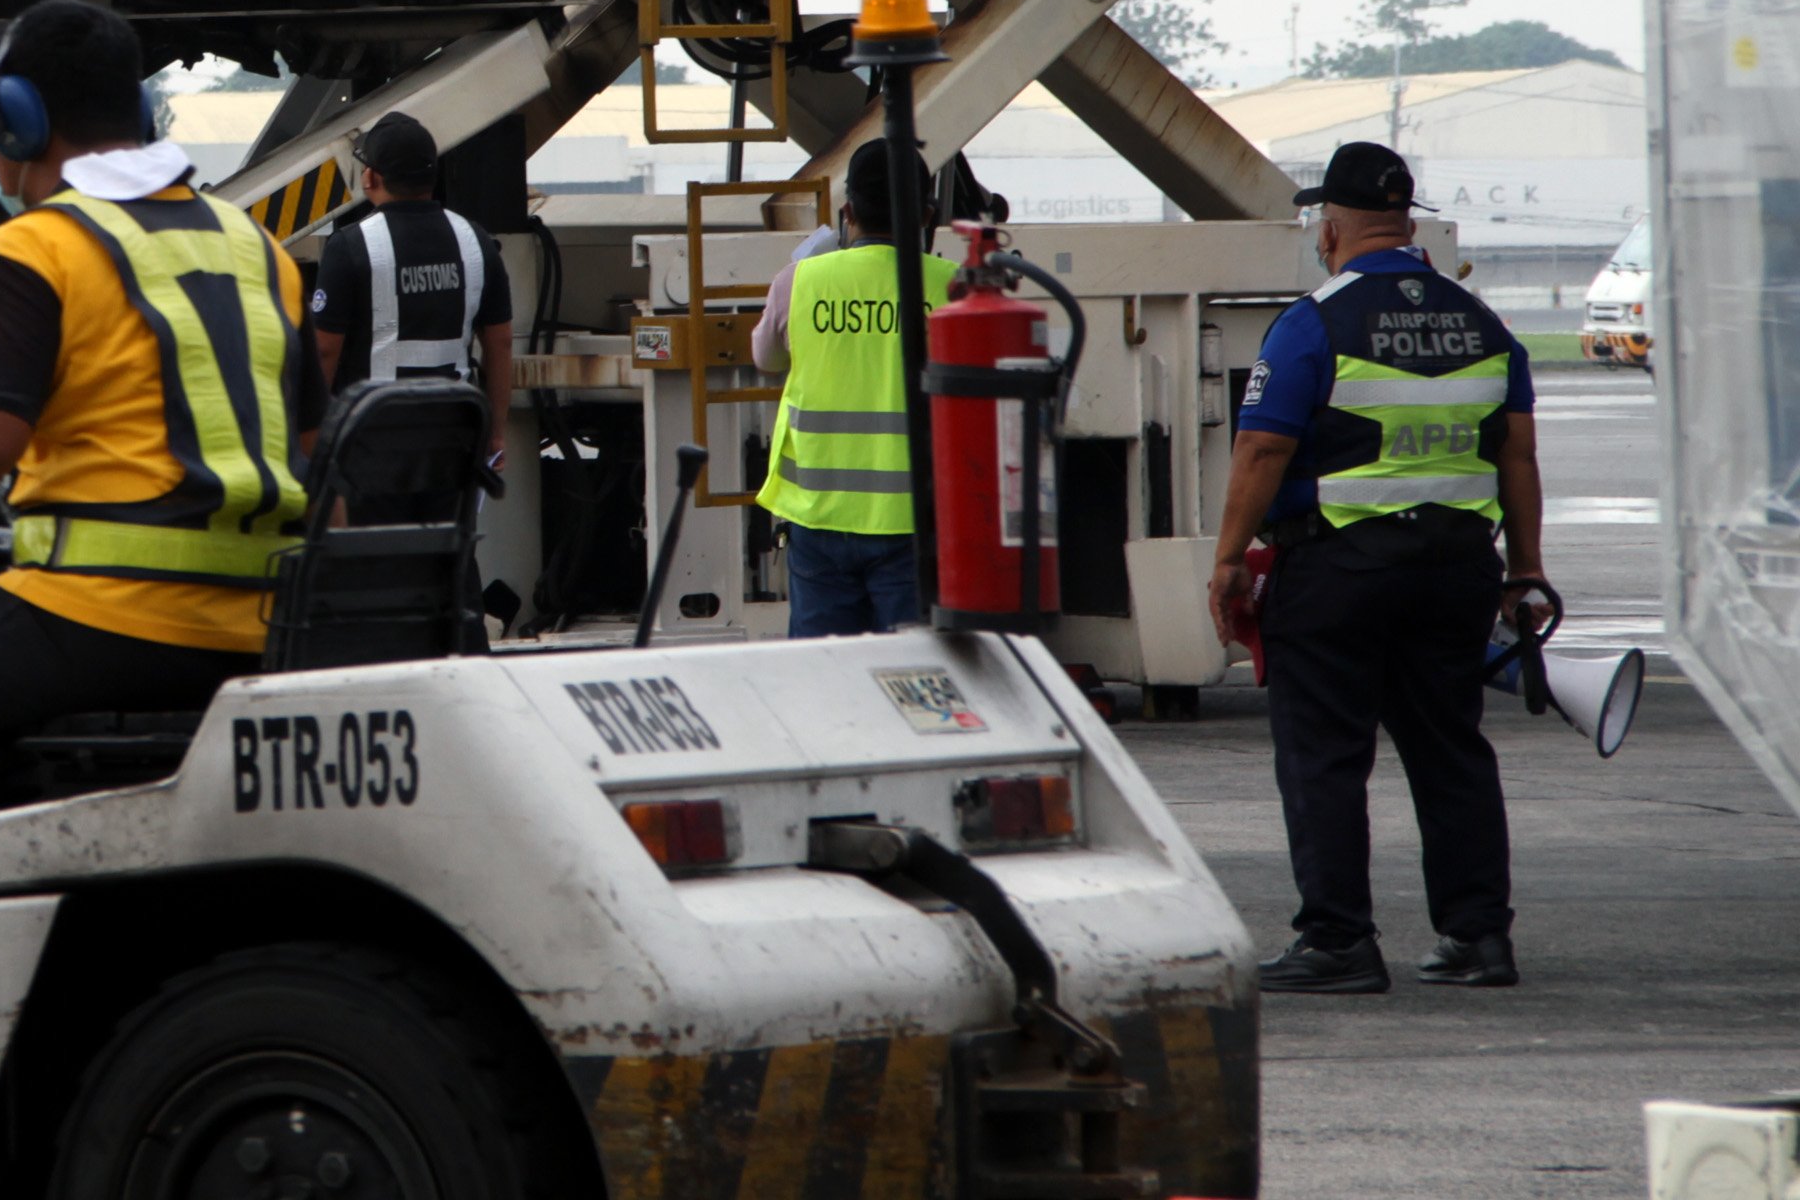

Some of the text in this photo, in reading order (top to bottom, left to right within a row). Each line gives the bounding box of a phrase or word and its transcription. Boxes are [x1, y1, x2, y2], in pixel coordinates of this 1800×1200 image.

[1023, 195, 1130, 219] Logistics
[400, 262, 460, 294] CUSTOMS
[813, 299, 933, 334] CUSTO
[1378, 312, 1467, 329] AIRPORT
[1370, 331, 1485, 358] POLICE
[1388, 423, 1475, 457] APD
[563, 676, 722, 755] BTR-053
[232, 709, 420, 813] BTR-053
